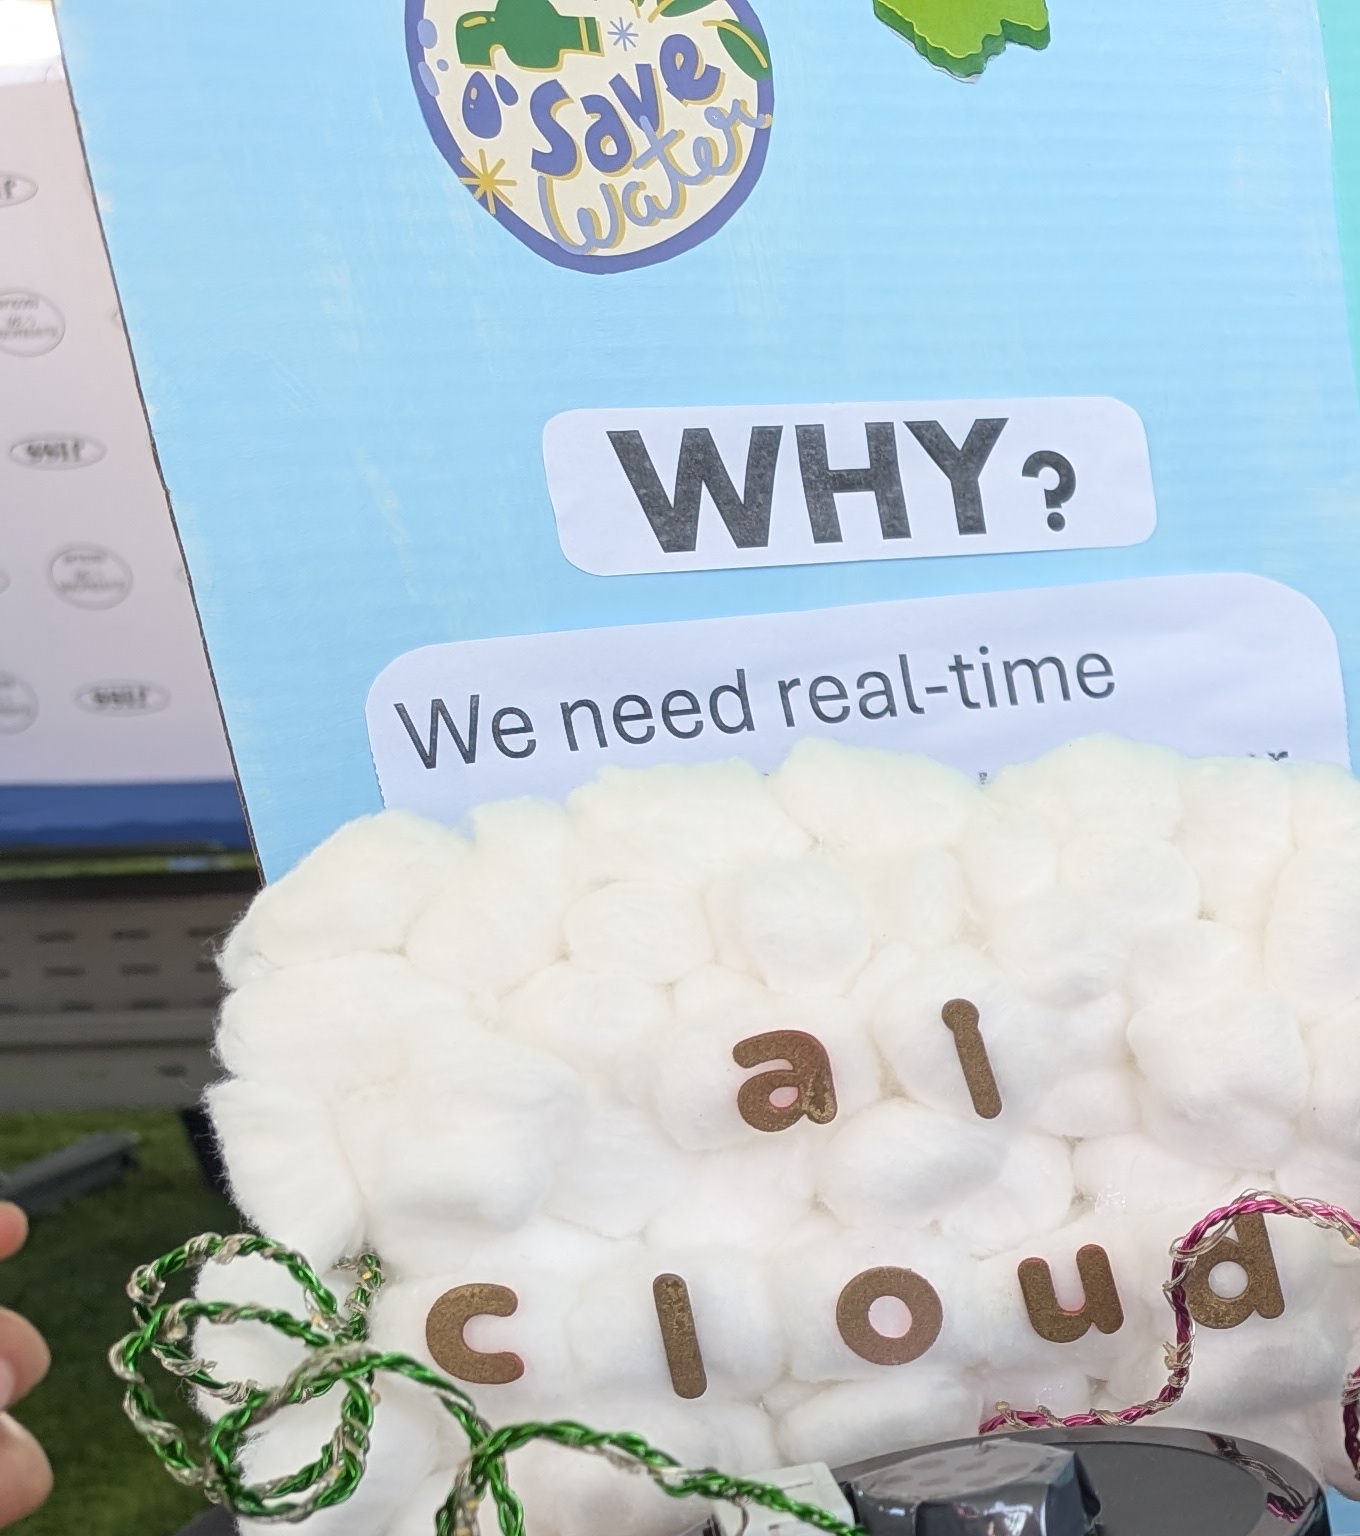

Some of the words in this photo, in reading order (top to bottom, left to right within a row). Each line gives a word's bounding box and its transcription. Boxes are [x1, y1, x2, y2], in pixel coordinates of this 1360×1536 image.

[393, 693, 537, 770] We
[560, 667, 756, 752] need
[778, 645, 1116, 728] real-time
[424, 1210, 1287, 1400] cloud
